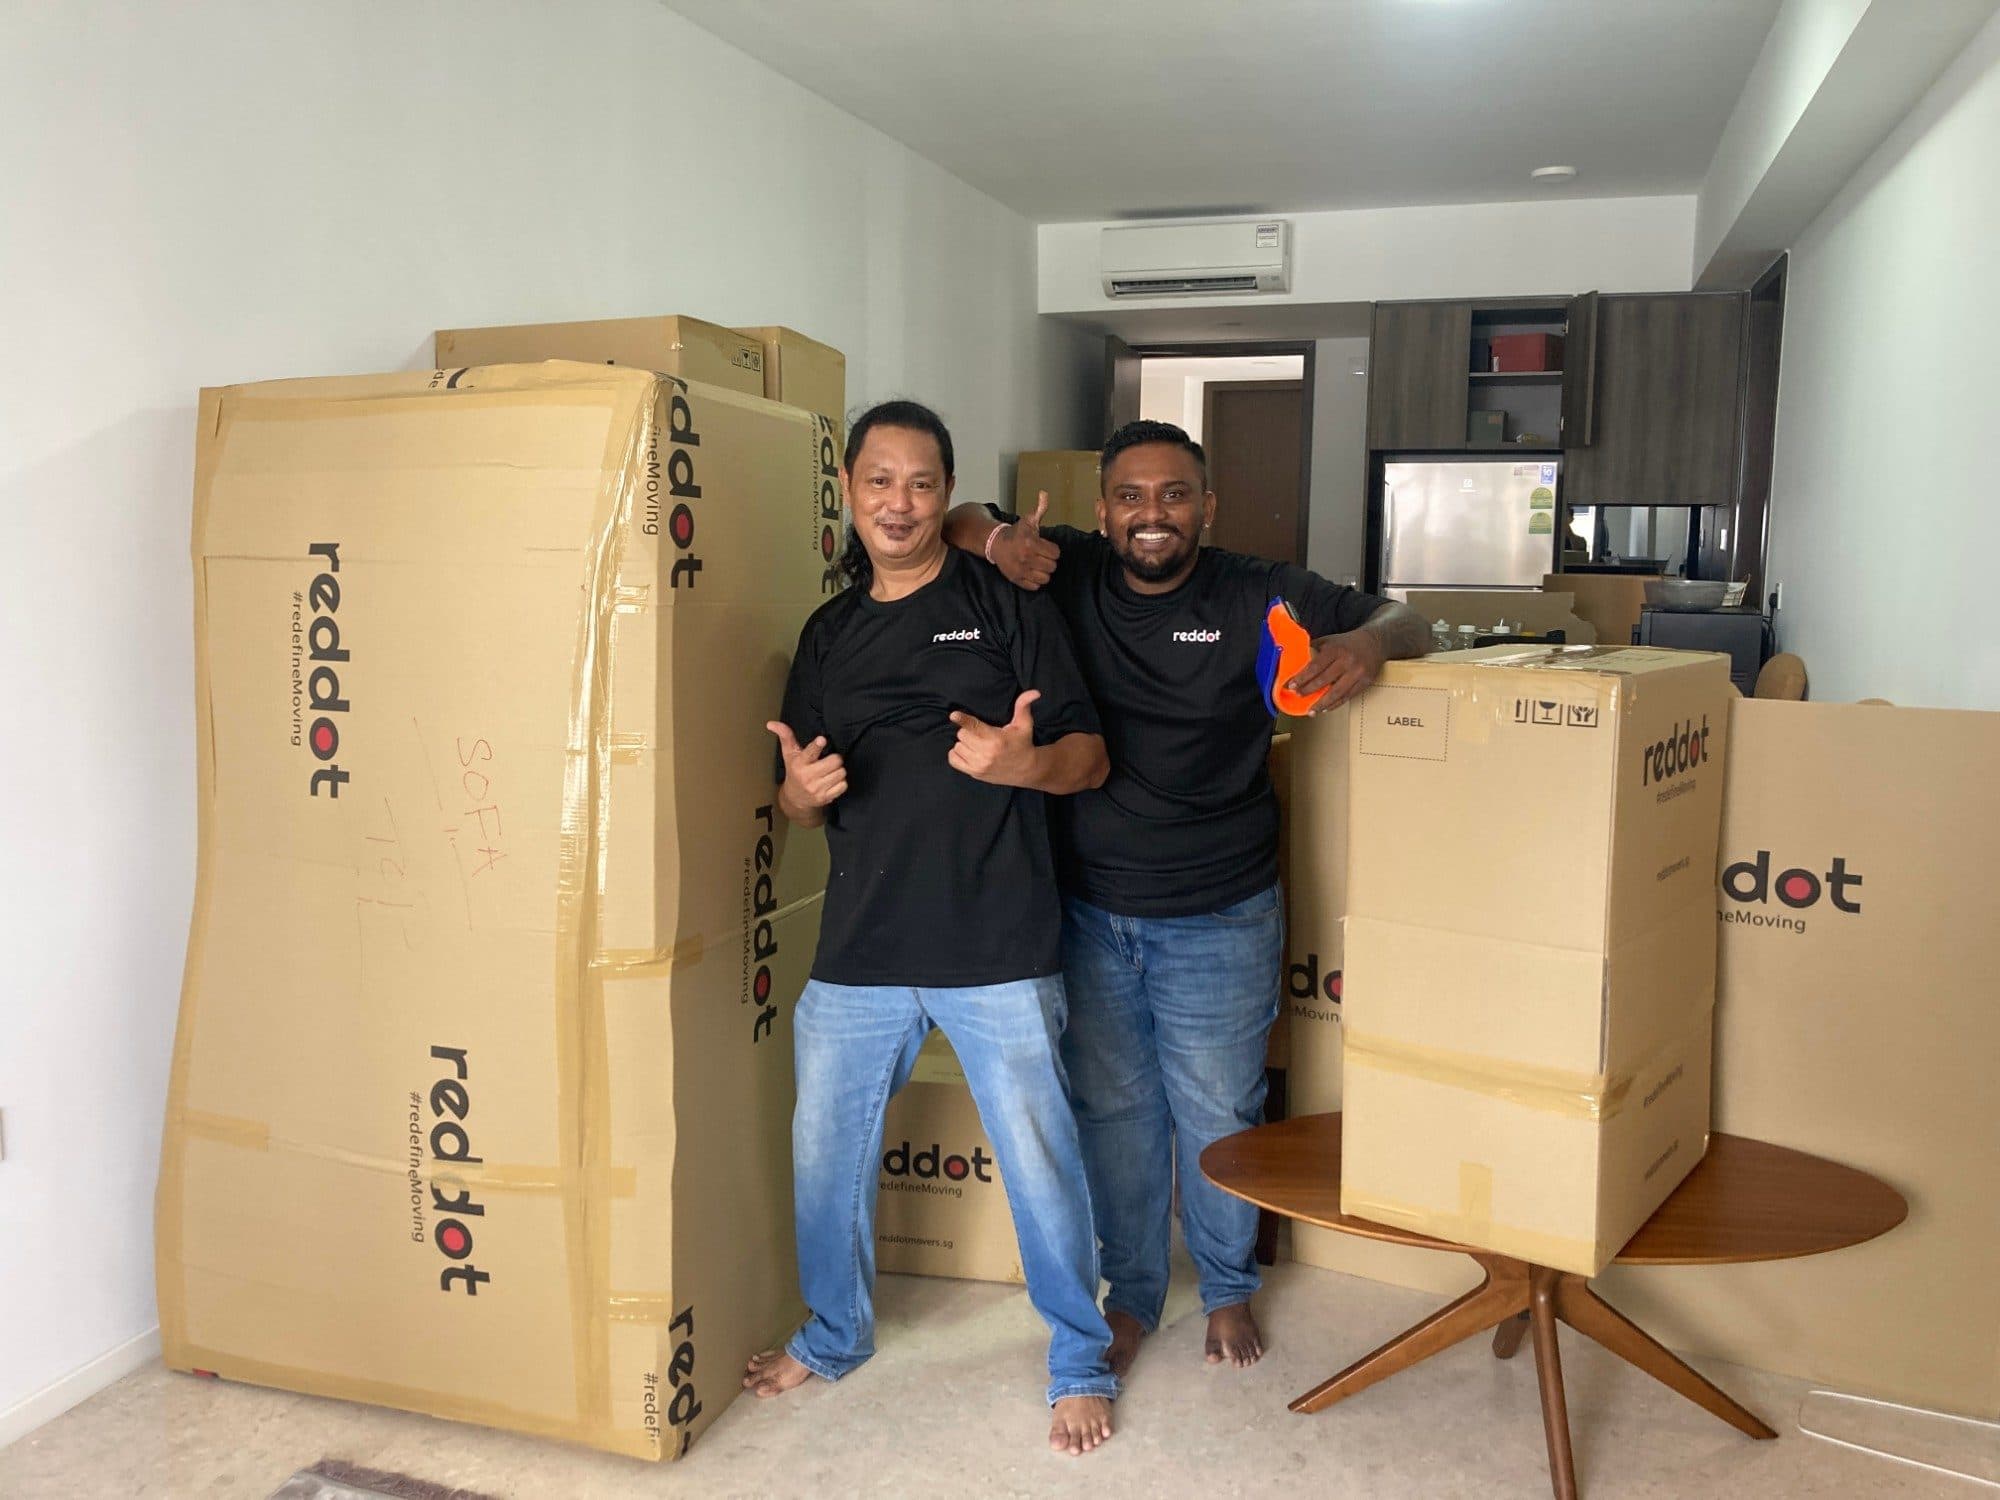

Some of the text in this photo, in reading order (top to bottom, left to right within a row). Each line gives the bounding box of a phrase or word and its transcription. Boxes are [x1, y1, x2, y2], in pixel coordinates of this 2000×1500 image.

[658, 373, 702, 588] ddot
[290, 591, 303, 747] #redefineMoving
[309, 543, 350, 798] reddot
[932, 628, 980, 642] reddot
[1173, 629, 1221, 642] reddot
[1387, 716, 1424, 727] LABEL
[1643, 714, 1709, 786] reddot
[457, 737, 508, 878] SOFA
[754, 804, 778, 1044] reddot
[1722, 850, 1863, 914] dot
[408, 1091, 427, 1243] #redefineMoving
[430, 1045, 490, 1296] reddot
[880, 1180, 962, 1199] edefineMoving
[882, 1141, 992, 1183] ddot
[668, 1305, 702, 1456] red
